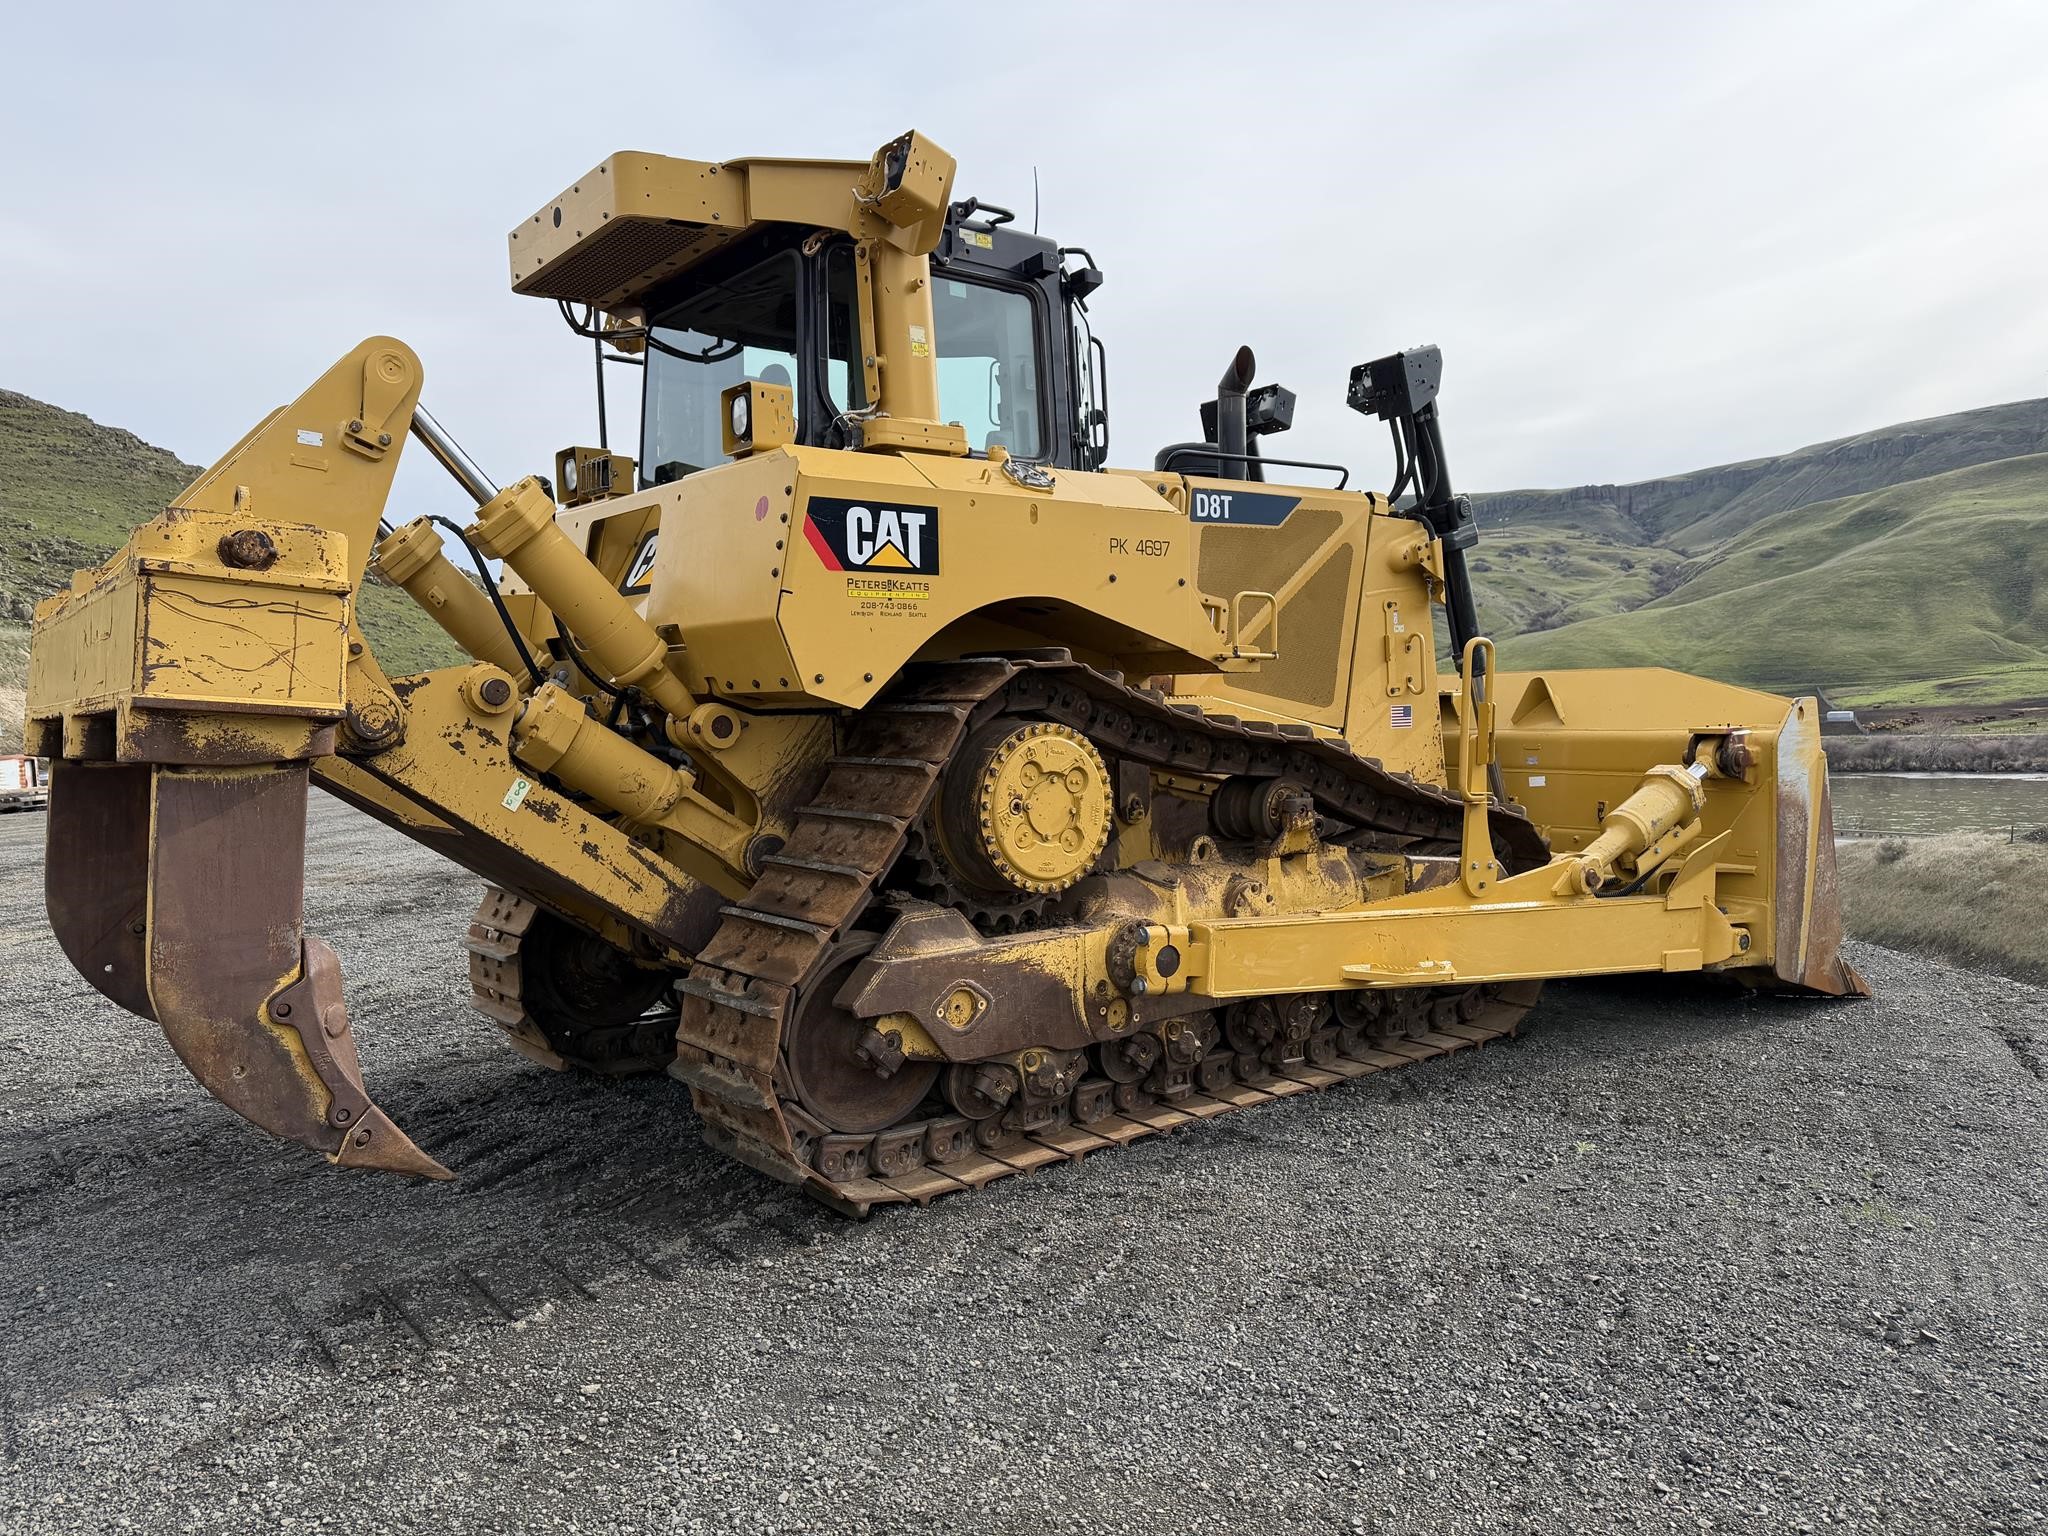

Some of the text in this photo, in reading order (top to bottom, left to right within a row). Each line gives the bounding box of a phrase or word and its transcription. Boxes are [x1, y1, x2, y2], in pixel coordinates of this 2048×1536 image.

[1196, 493, 1233, 519] D8T
[846, 506, 926, 569] CAT
[1110, 538, 1171, 557] PK 4697
